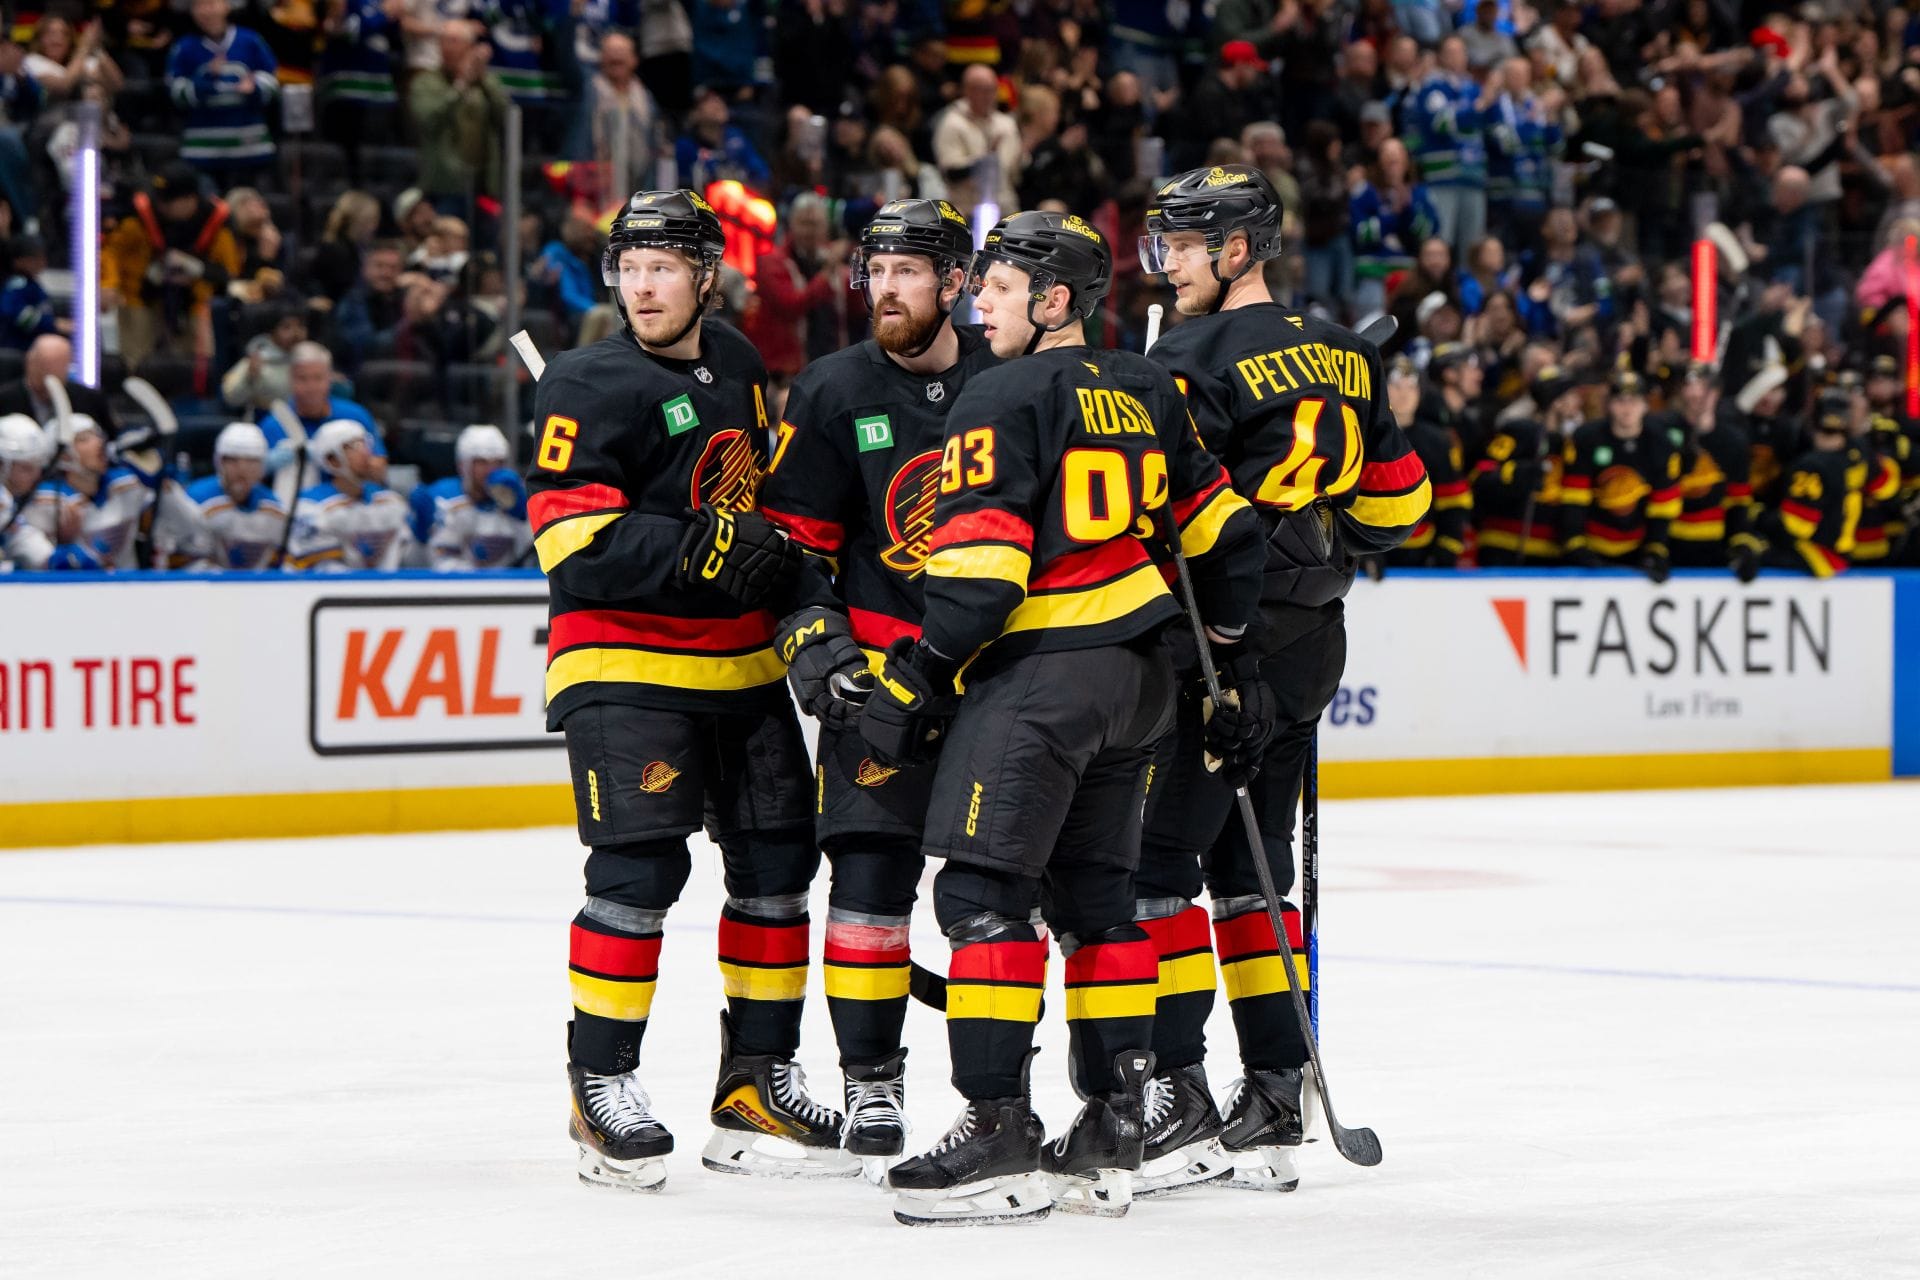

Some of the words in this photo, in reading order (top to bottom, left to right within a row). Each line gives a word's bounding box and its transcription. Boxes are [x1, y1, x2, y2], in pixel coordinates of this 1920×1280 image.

[1207, 173, 1248, 187] NexGen
[626, 219, 662, 228] CCM
[1062, 219, 1101, 243] NexGen
[667, 401, 693, 427] TD
[753, 384, 768, 428] A
[537, 413, 580, 473] 6
[859, 421, 889, 444] TD
[940, 426, 996, 495] 93
[783, 618, 825, 664] CM
[1549, 598, 1832, 676] FASKEN
[72, 656, 197, 729] TIRE
[336, 628, 523, 719] KAL
[588, 769, 601, 822] CCM
[966, 781, 983, 837] CCM
[733, 1099, 778, 1131] CCM
